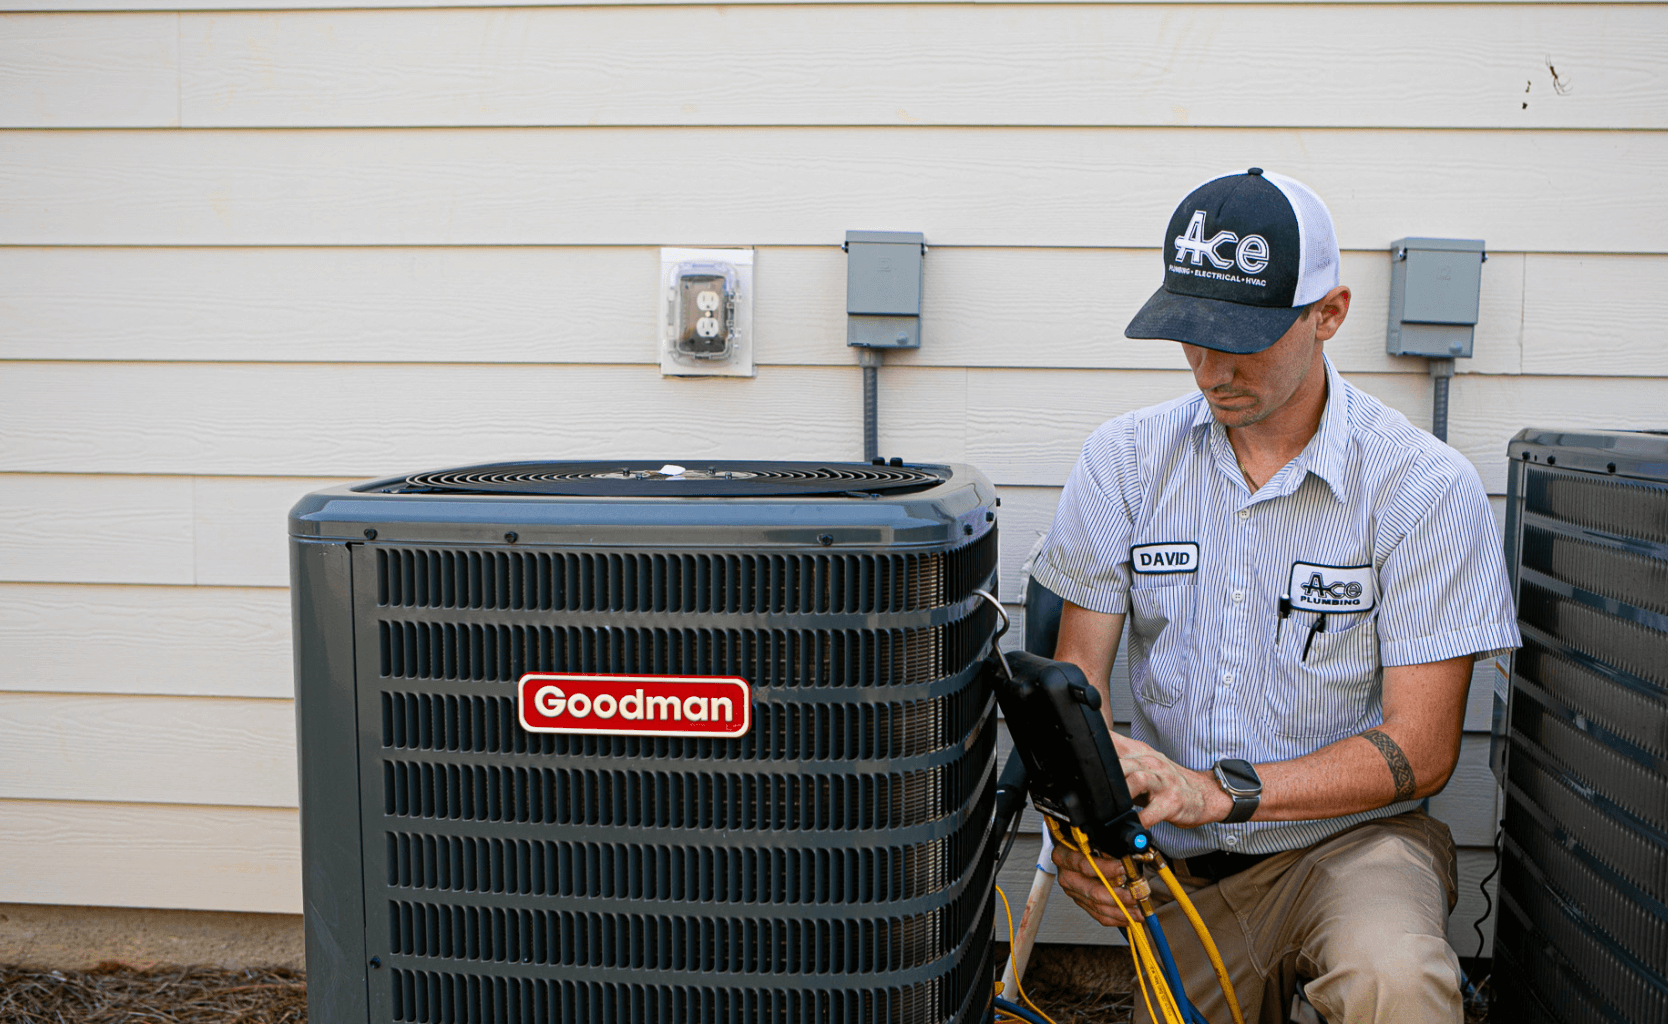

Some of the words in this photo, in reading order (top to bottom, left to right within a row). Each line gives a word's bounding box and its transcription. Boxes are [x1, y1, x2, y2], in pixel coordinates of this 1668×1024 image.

[1174, 209, 1270, 274] Ace
[1194, 269, 1241, 283] ELECTRICAL
[1245, 276, 1267, 287] HVAC
[1140, 551, 1190, 567] DAVID
[1301, 572, 1362, 599] Ace
[1300, 595, 1361, 606] PLUMBING
[534, 685, 733, 722] Goodman
